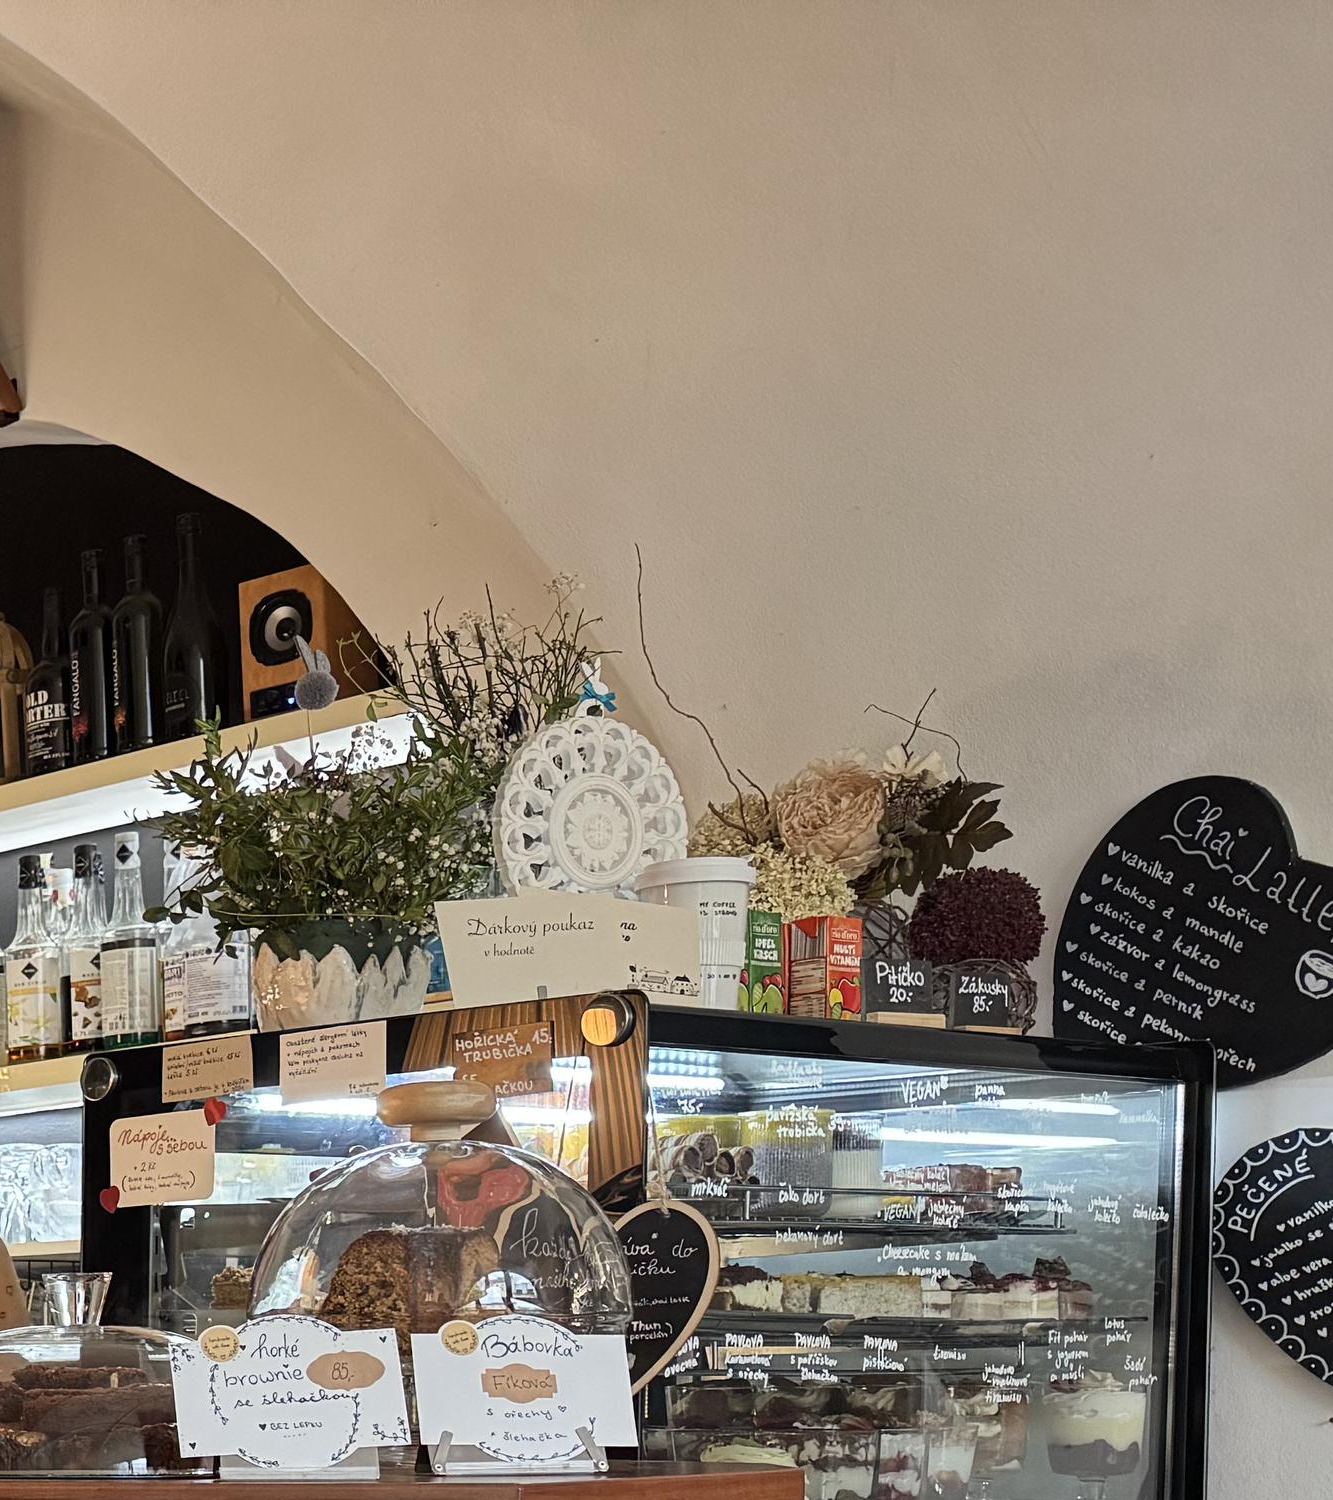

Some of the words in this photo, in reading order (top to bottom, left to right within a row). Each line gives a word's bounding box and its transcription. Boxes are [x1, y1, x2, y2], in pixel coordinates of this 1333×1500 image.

[1173, 796, 1244, 861] Chai
[1120, 849, 1175, 886] vanilka
[1182, 882, 1196, 897] a
[1208, 895, 1269, 935] skořice
[467, 915, 537, 937] Dárkový
[542, 912, 595, 936] poukaz
[1112, 876, 1156, 911] kokos
[1162, 906, 1175, 920] a
[1185, 915, 1245, 954] mandle
[484, 949, 490, 957] v
[493, 941, 535, 957] hodnotě
[1094, 901, 1146, 935] skořice
[1152, 928, 1164, 942] a
[1172, 934, 1221, 970] kakao
[875, 960, 925, 987] Pitíčko
[1099, 929, 1151, 963] zázvor
[1154, 958, 1166, 971] a
[1172, 962, 1256, 1014] lemongrass
[958, 975, 1009, 1007] Zákusky
[1079, 950, 1129, 983] skořice
[1133, 978, 1147, 992] a
[1153, 988, 1205, 1021] perník
[1071, 977, 1122, 1011] skořice
[1124, 1005, 1137, 1019] a
[1141, 1013, 1195, 1043] pekan
[1077, 1009, 1127, 1045] skořice
[455, 1030, 519, 1052] HOŘICKÁ
[462, 1042, 533, 1063] TRUBIČKA
[494, 1080, 534, 1095] AČKOU
[900, 1078, 941, 1105] VEGAN
[1227, 1148, 1312, 1234] PEČENÉ
[672, 1238, 699, 1258] do
[1259, 1236, 1304, 1268] jablko
[1307, 1229, 1324, 1242] se
[1269, 1269, 1301, 1288] aloe
[250, 1332, 301, 1360] horké
[480, 1334, 574, 1359] Bábovka
[223, 1362, 305, 1388] brownie
[504, 1408, 552, 1421] ořechy
[502, 1431, 568, 1442] šlehačka
